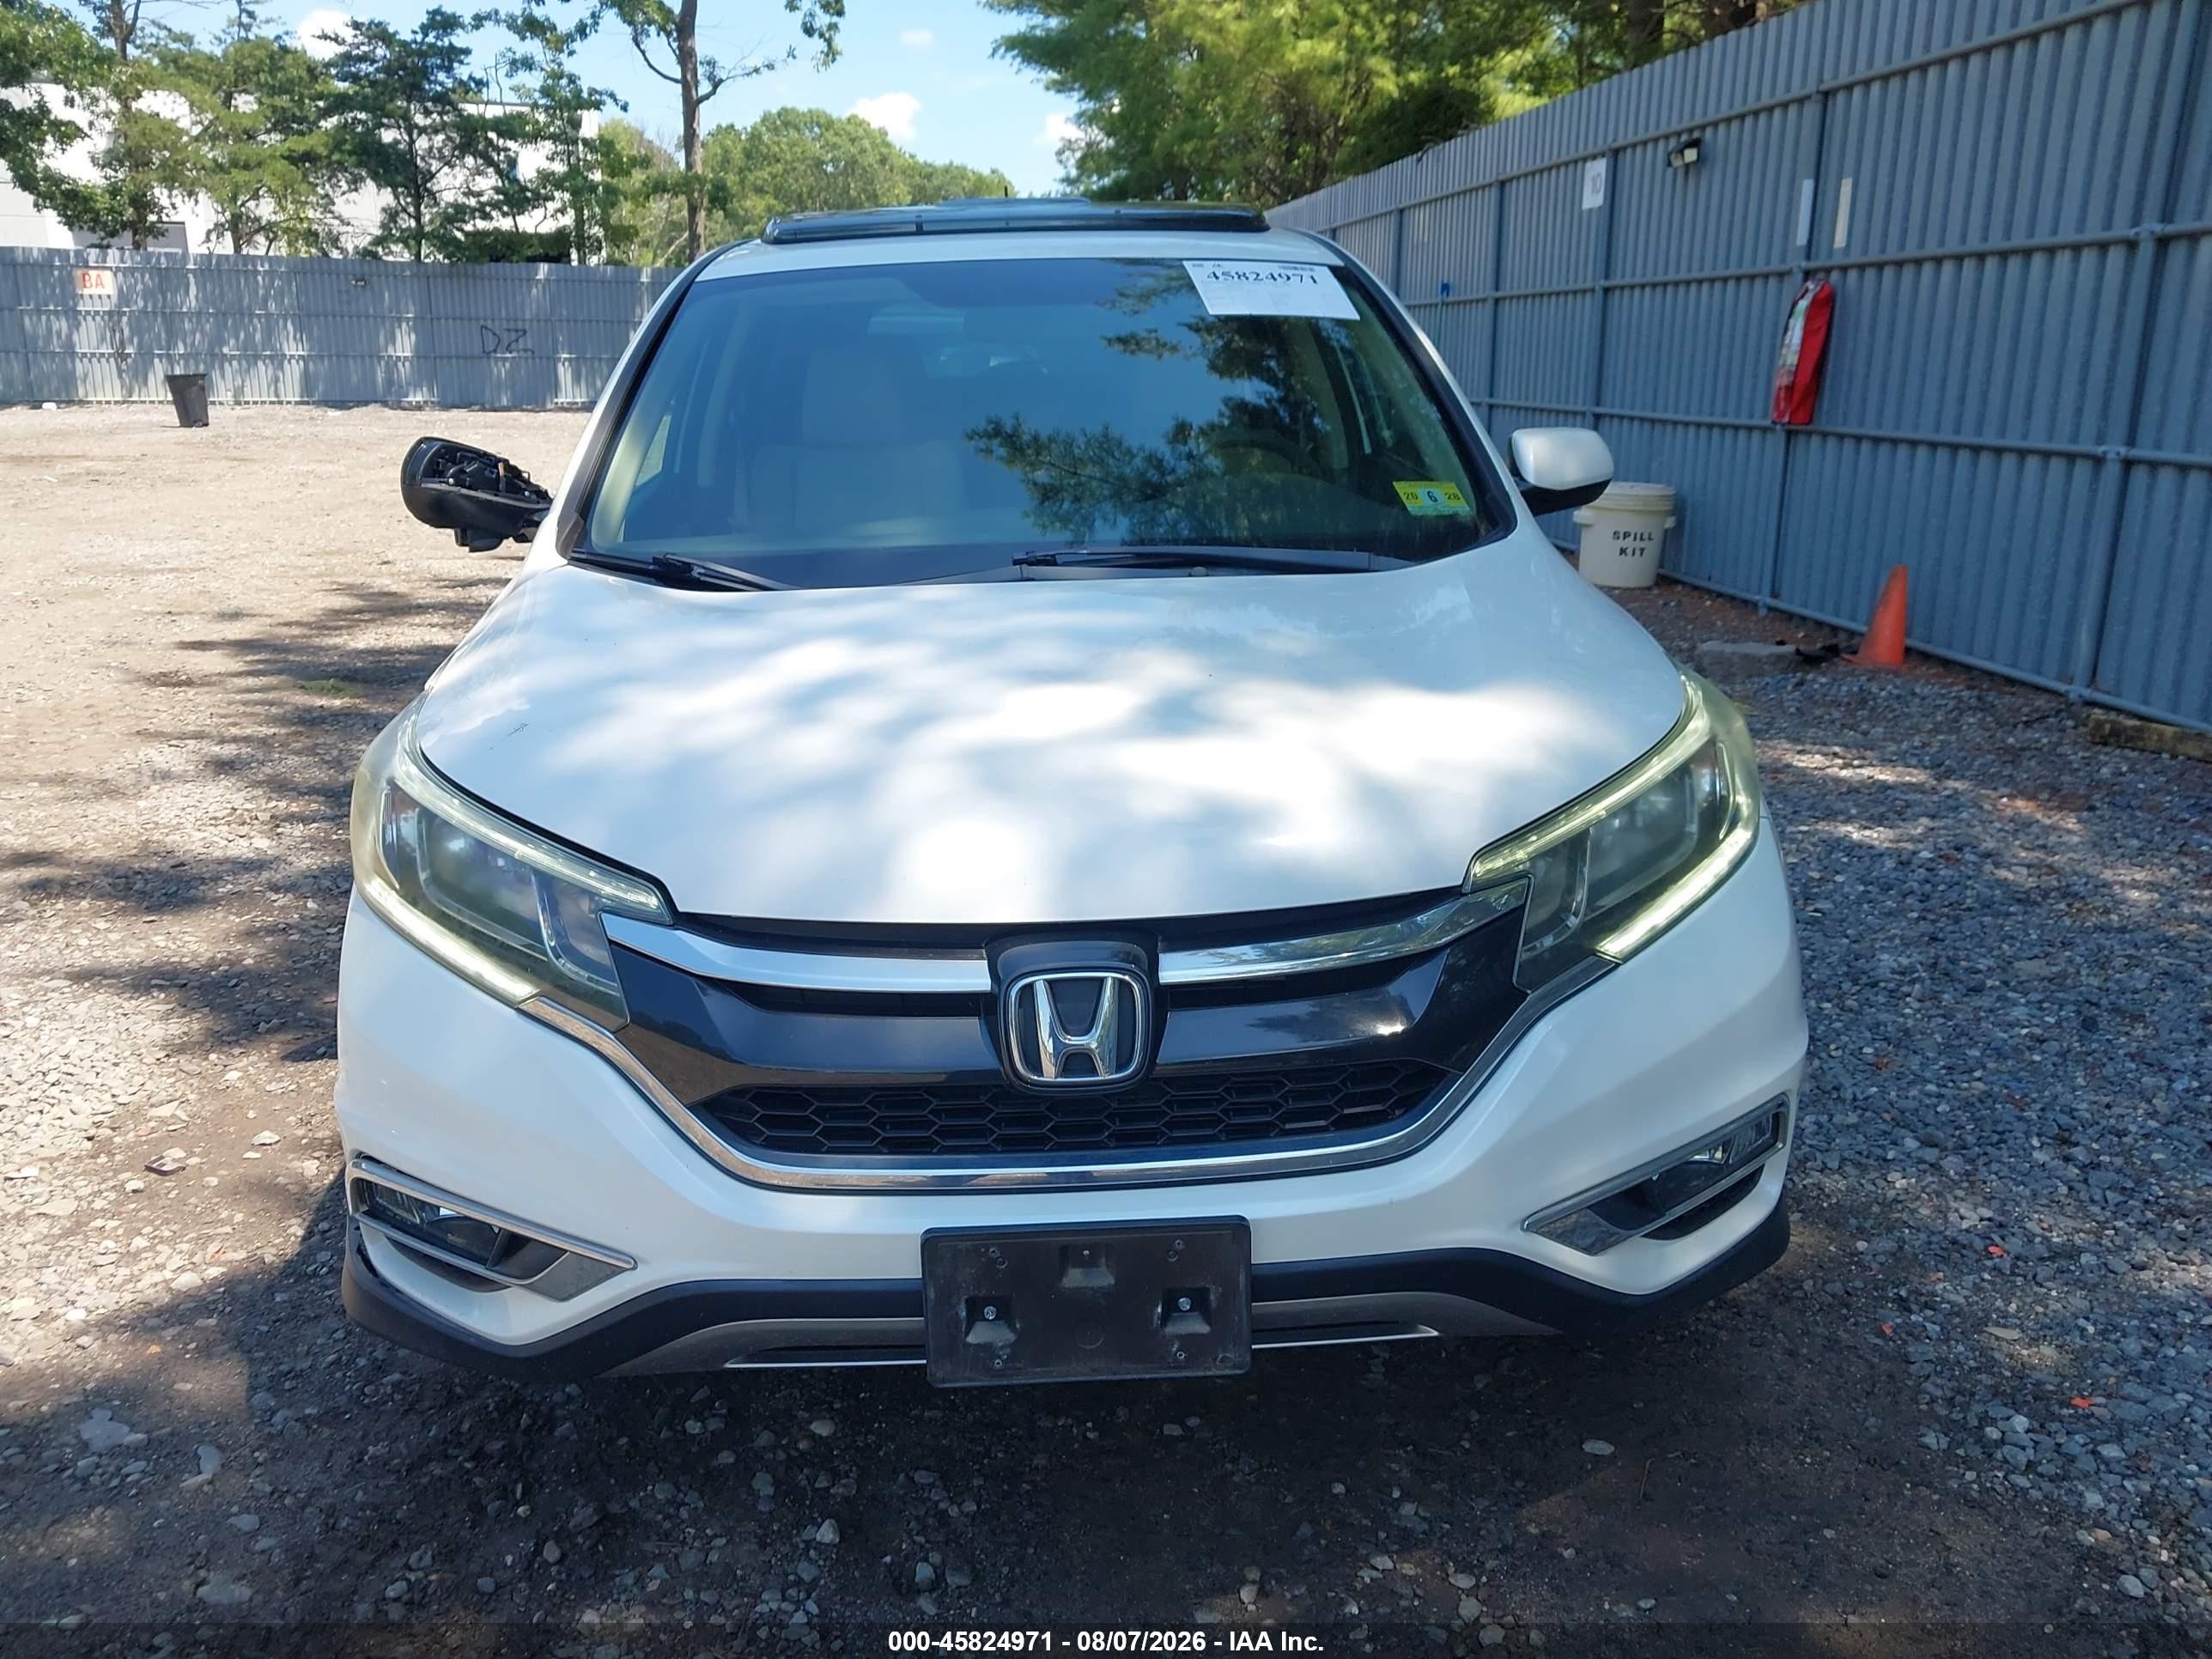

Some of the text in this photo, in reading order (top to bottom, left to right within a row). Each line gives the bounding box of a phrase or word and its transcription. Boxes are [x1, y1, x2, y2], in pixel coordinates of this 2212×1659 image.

[82, 272, 105, 289] BA
[1206, 270, 1318, 285] 45824971
[1426, 490, 1439, 503] 6
[1613, 530, 1654, 542] SPILL
[1619, 546, 1647, 557] KIT
